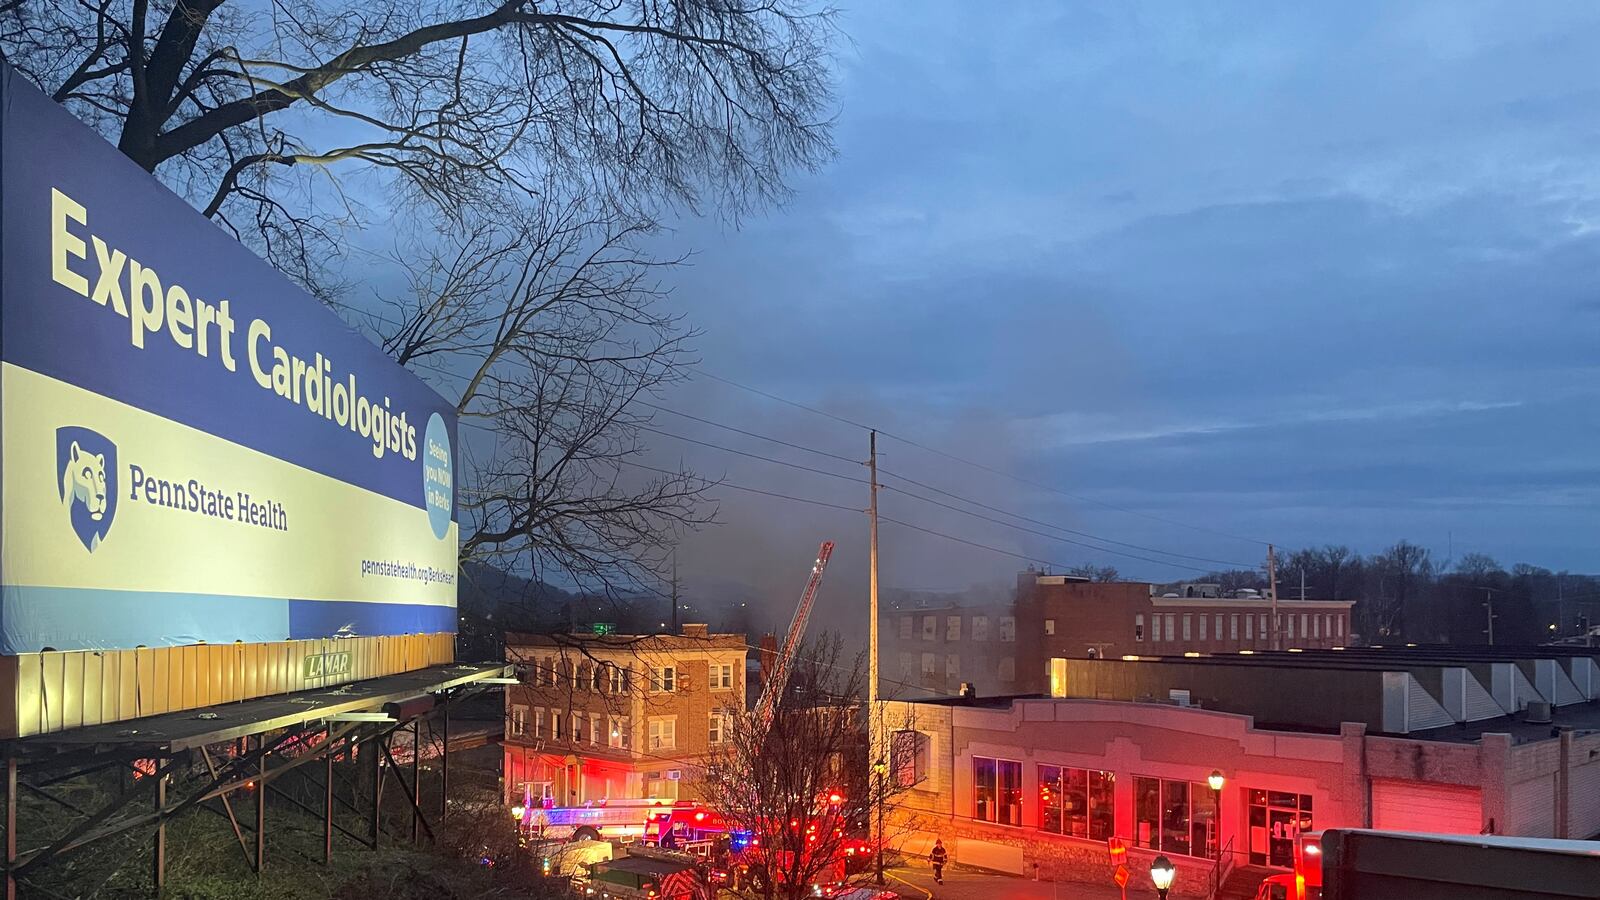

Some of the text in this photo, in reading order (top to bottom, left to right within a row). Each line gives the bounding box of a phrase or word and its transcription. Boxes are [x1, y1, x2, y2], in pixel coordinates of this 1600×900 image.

[51, 186, 416, 461] Expert Cardiologists
[429, 438, 448, 467] Seeing
[425, 465, 437, 482] you
[129, 464, 288, 531] PennState Health
[428, 486, 449, 511] in Berks
[309, 653, 348, 676] LAMAR
